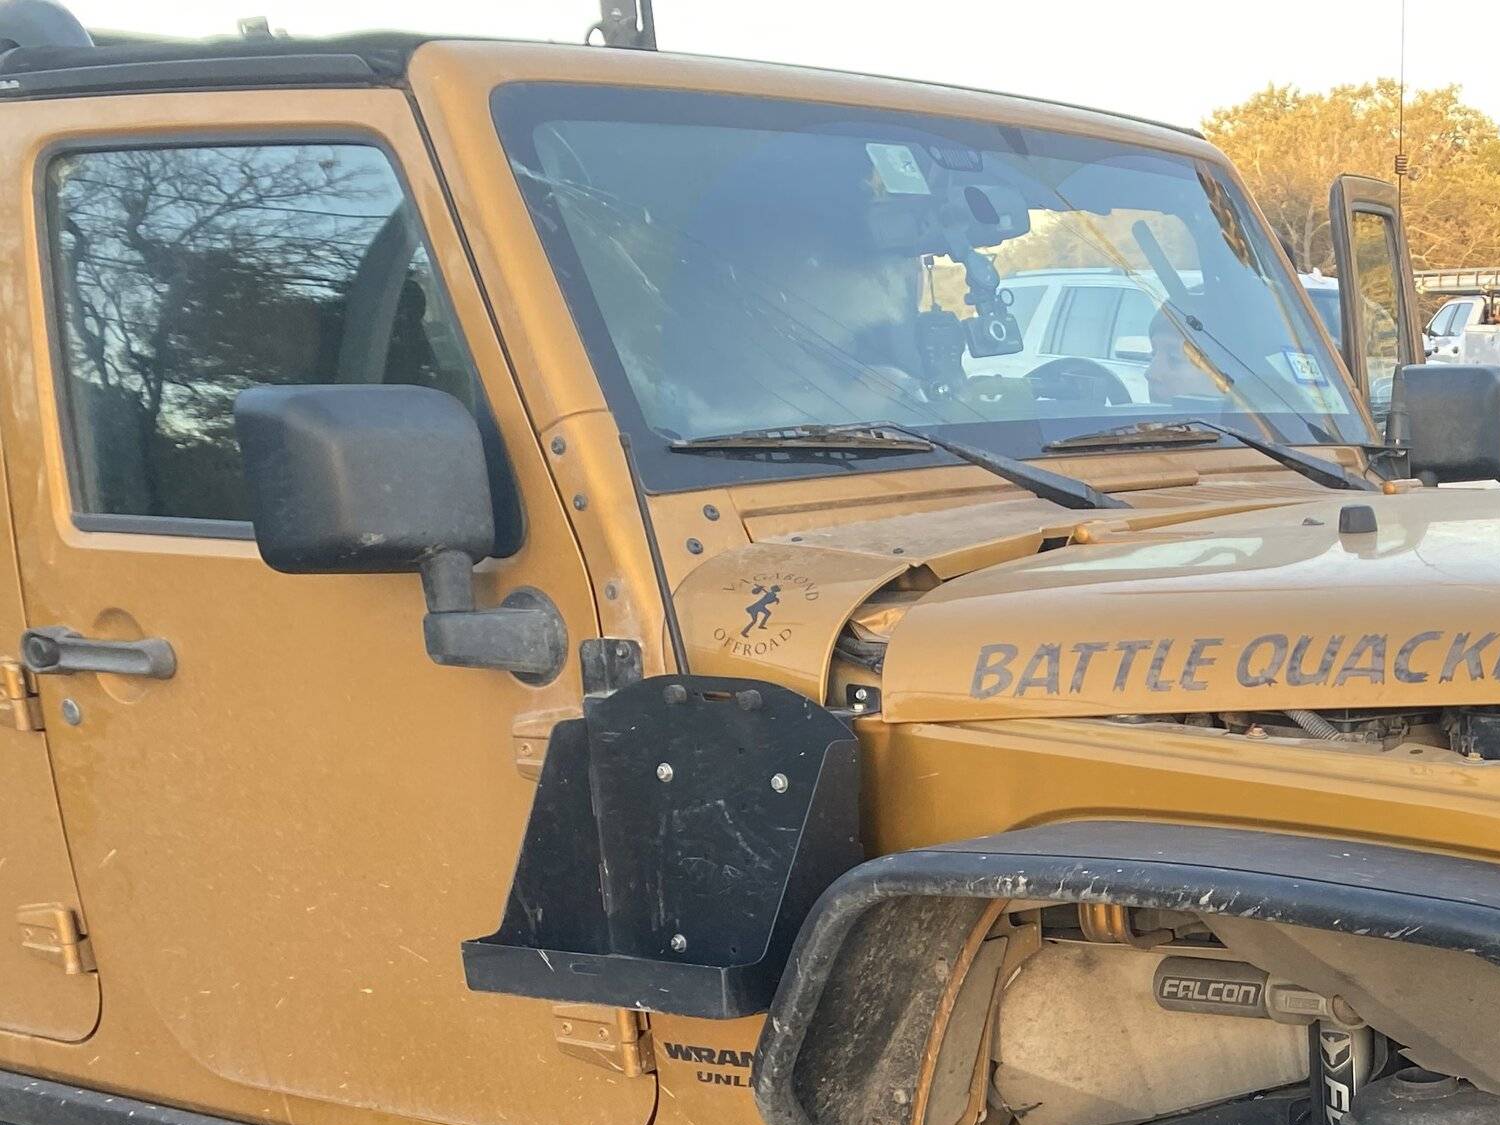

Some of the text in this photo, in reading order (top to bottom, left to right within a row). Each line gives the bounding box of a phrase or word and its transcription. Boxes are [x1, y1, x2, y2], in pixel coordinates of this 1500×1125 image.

[713, 627, 792, 656] OFFROAD
[969, 637, 1224, 699] BATTLE
[1162, 978, 1257, 1004] FALCON
